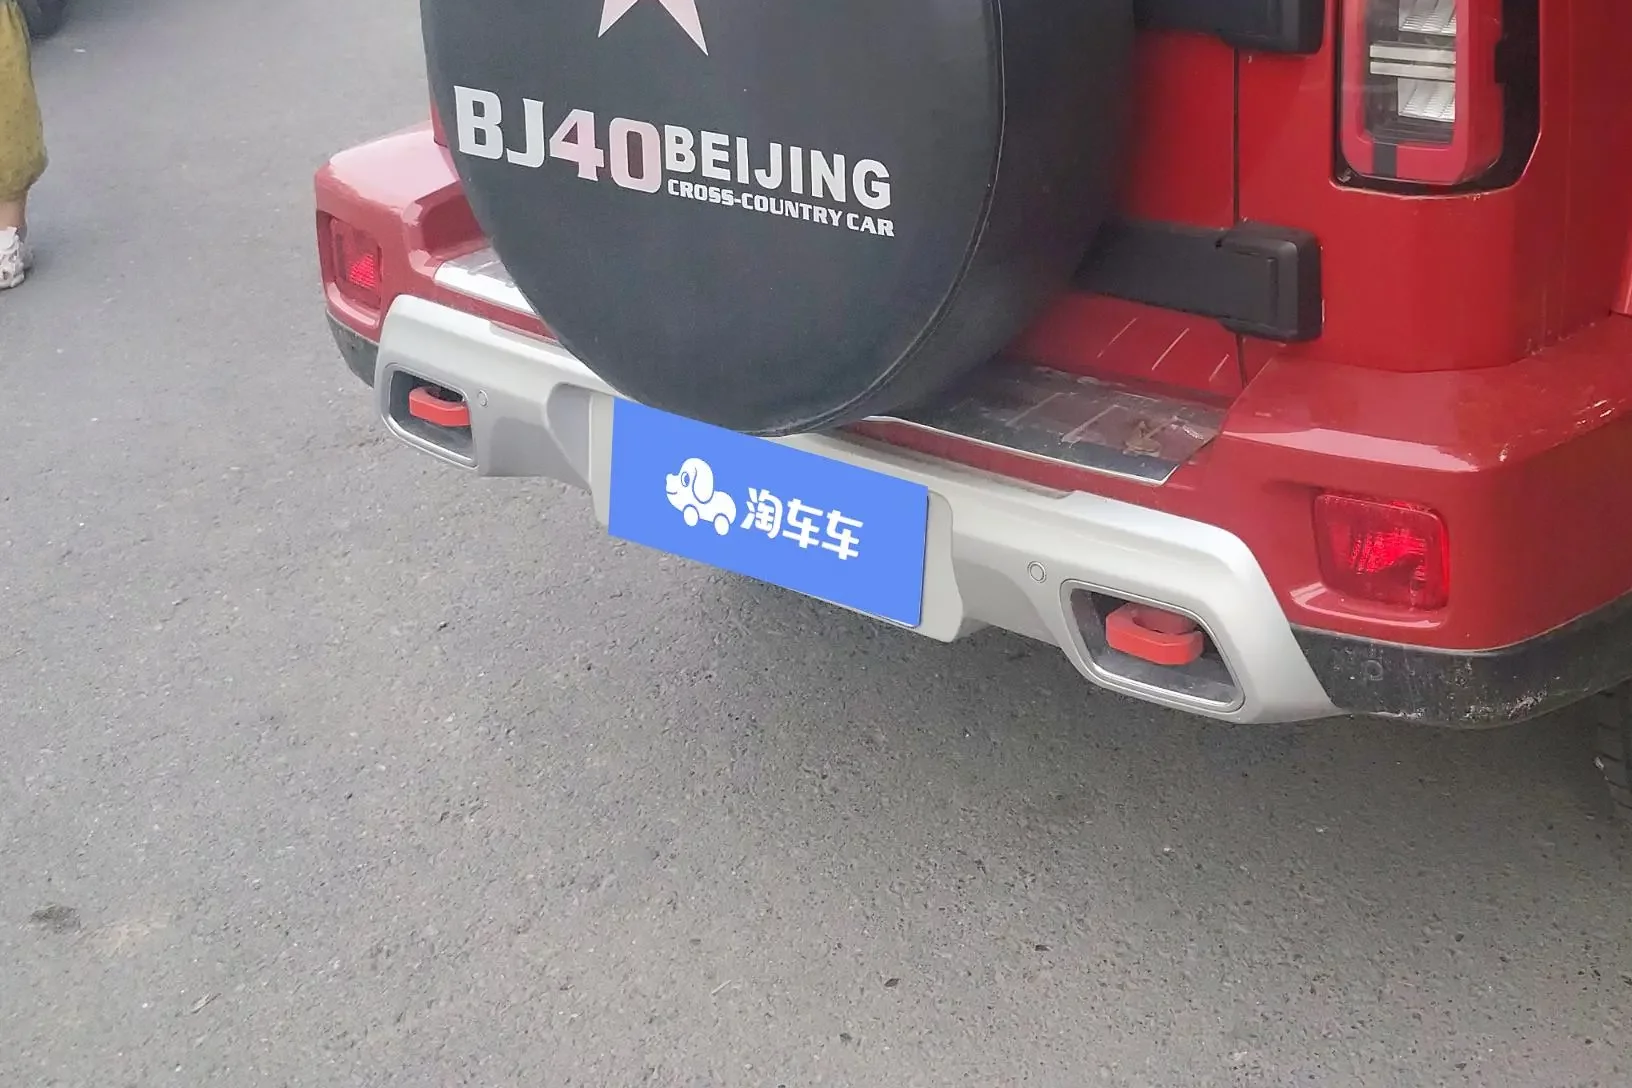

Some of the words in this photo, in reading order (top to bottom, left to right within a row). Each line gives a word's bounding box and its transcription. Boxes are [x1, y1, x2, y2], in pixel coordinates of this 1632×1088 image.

[454, 85, 662, 194] BJ40
[664, 124, 891, 210] BEIJING
[667, 178, 843, 227] CROSS-COUNTRY
[846, 213, 895, 238] CAR
